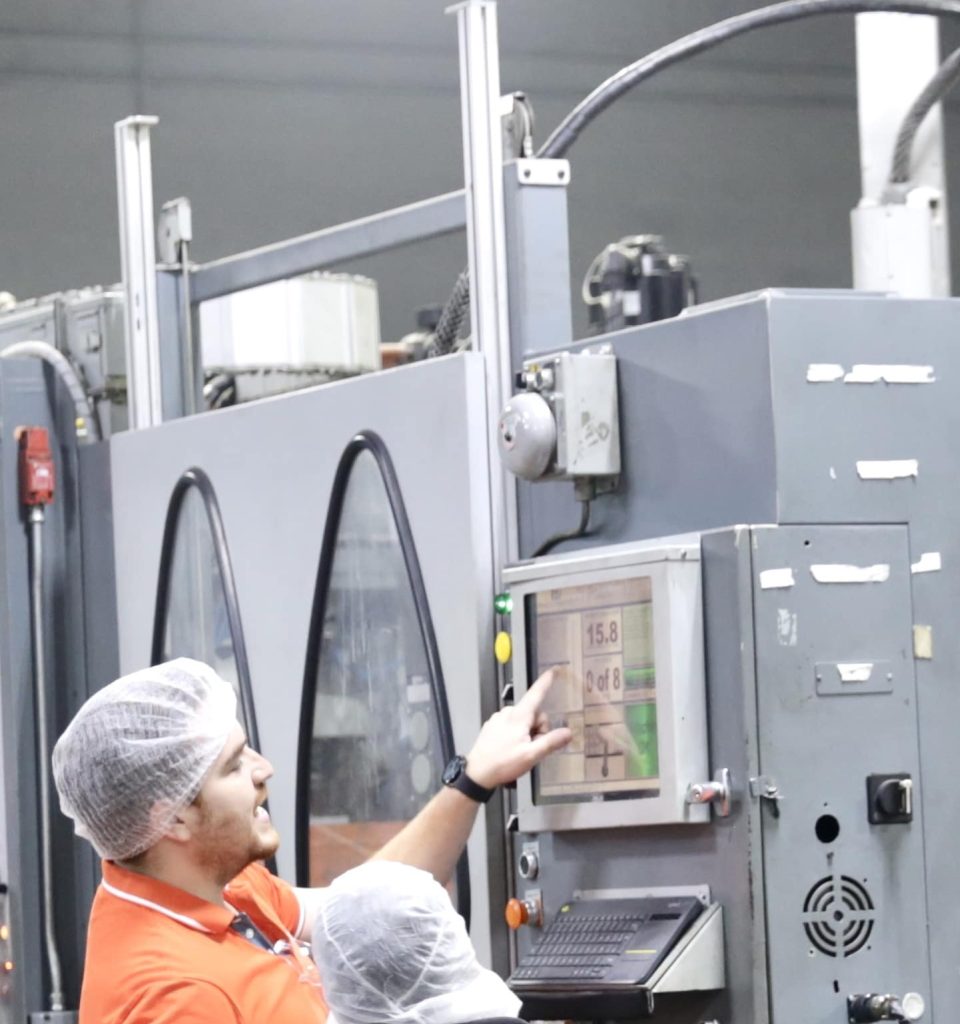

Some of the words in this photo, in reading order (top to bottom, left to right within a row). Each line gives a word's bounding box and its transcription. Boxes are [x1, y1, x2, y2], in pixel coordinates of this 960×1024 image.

[586, 620, 618, 645] 15.8
[597, 667, 610, 692] of
[612, 667, 621, 690] 8
